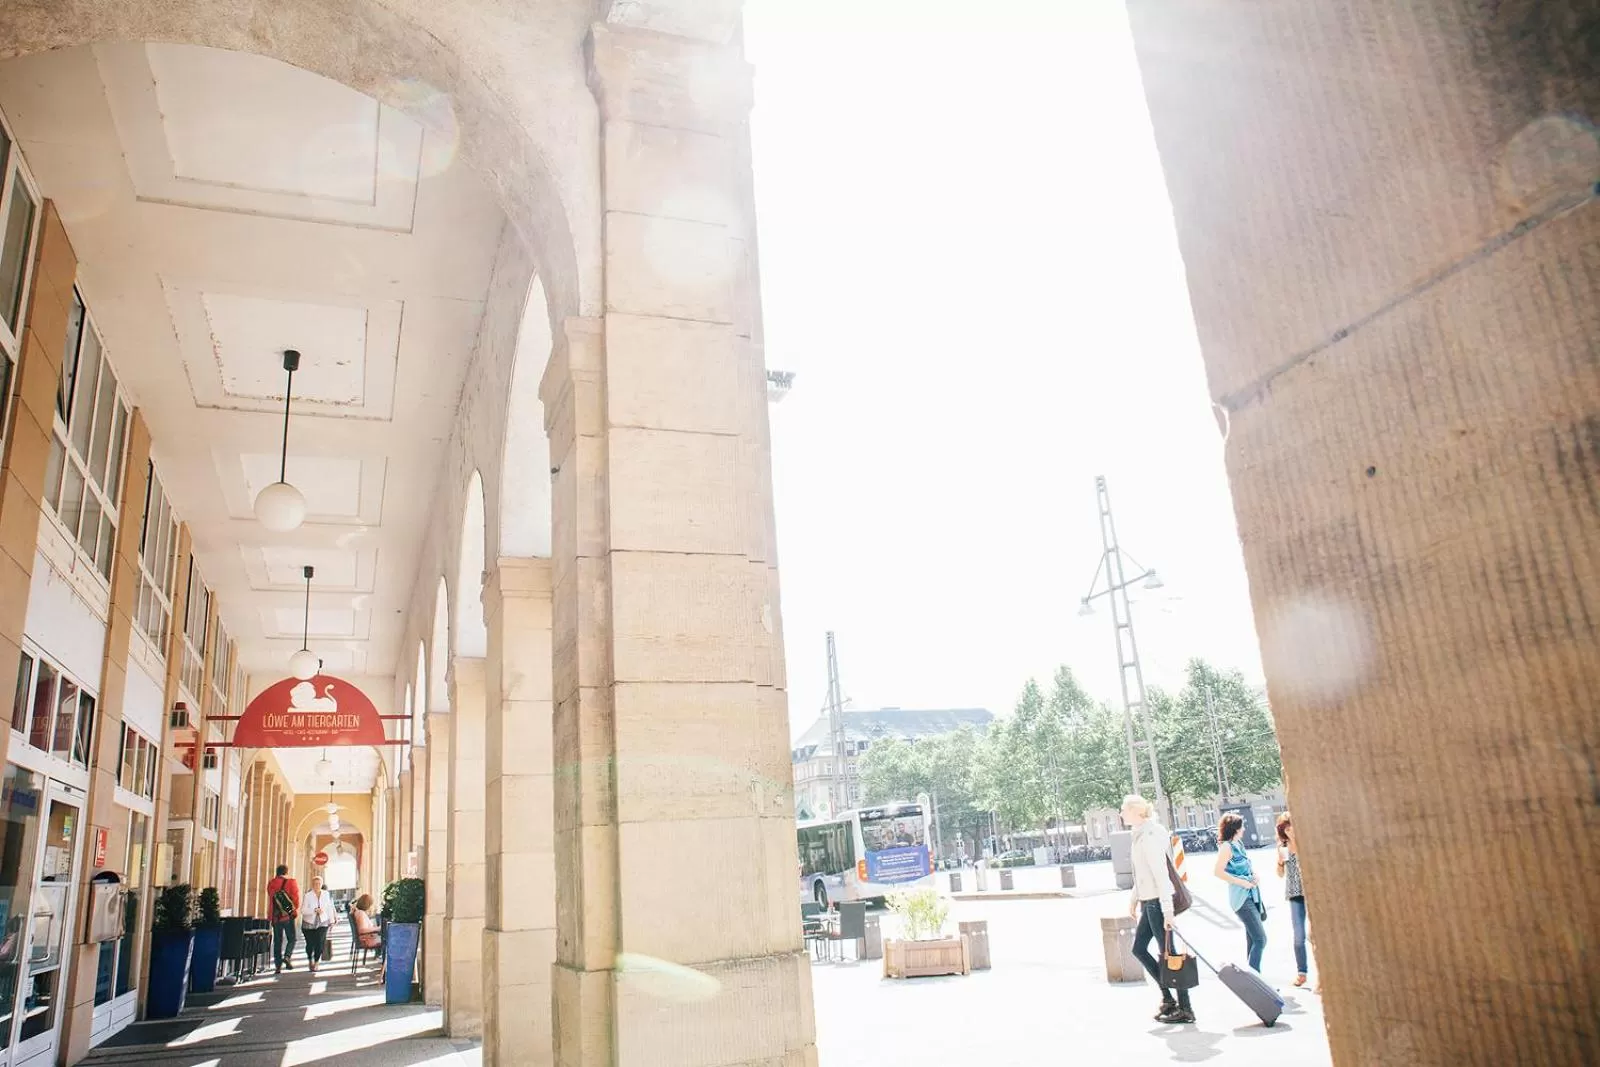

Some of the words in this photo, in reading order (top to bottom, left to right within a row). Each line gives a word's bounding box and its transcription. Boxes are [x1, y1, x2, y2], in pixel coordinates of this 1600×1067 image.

[263, 713, 288, 728] LÖWE
[291, 714, 305, 728] AM
[307, 714, 360, 728] TIERGARTEN
